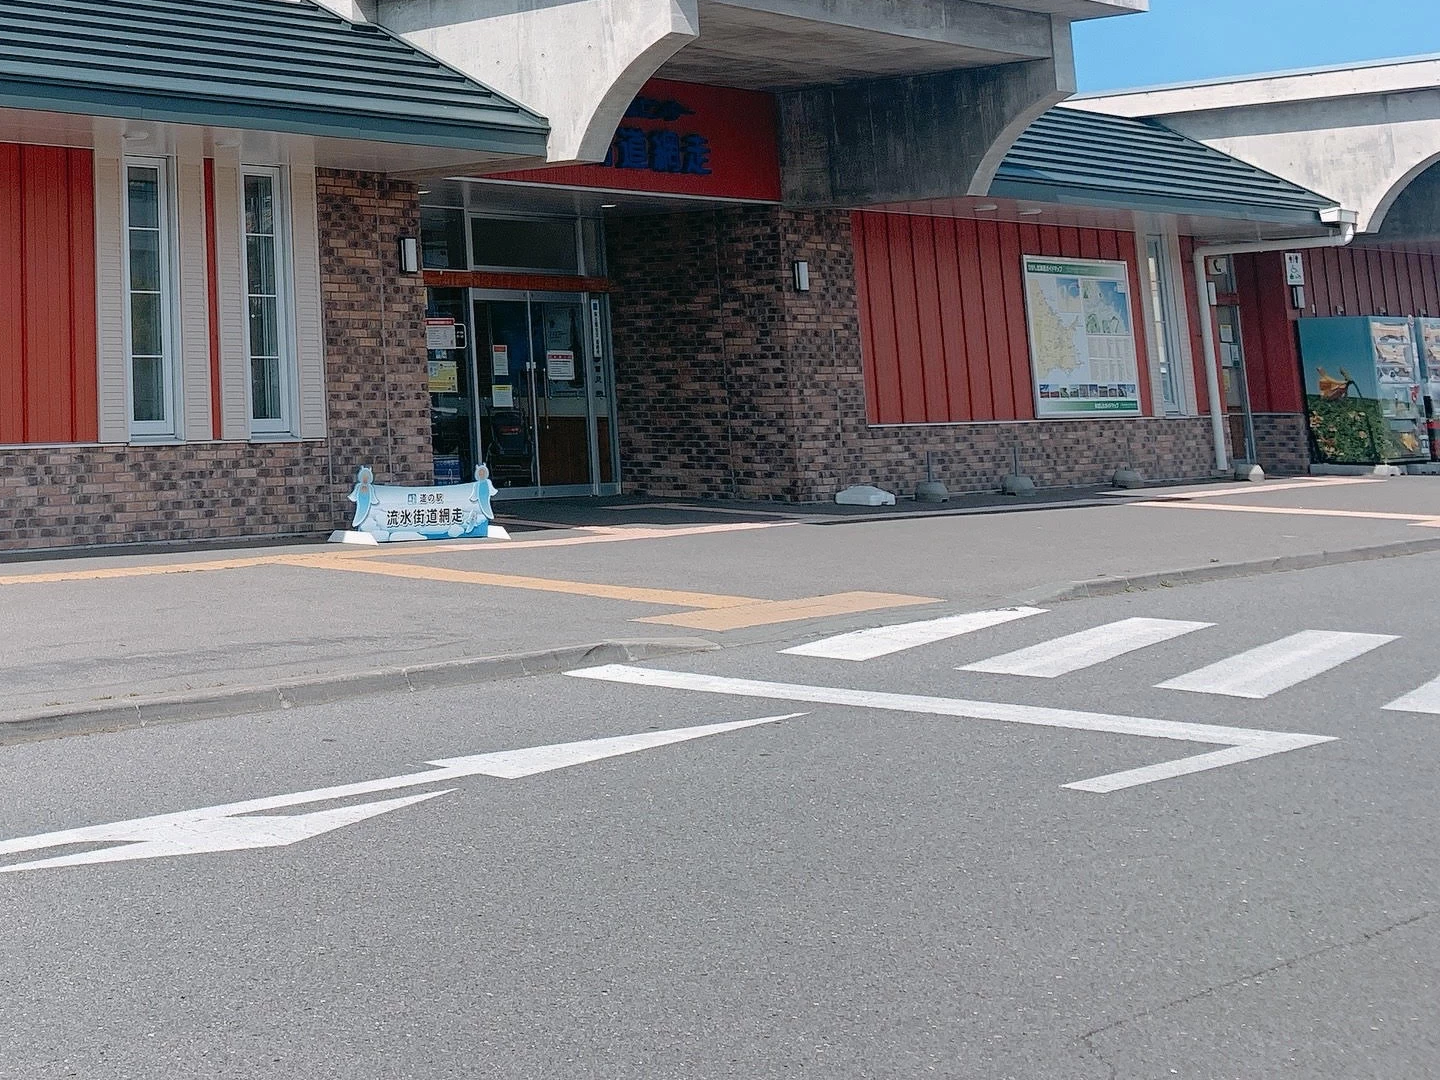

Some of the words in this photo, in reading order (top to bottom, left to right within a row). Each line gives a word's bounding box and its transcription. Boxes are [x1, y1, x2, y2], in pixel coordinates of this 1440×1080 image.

[604, 126, 712, 175] 道網走
[419, 493, 445, 504] 道の駅
[386, 507, 463, 527] 流氷街道網走
